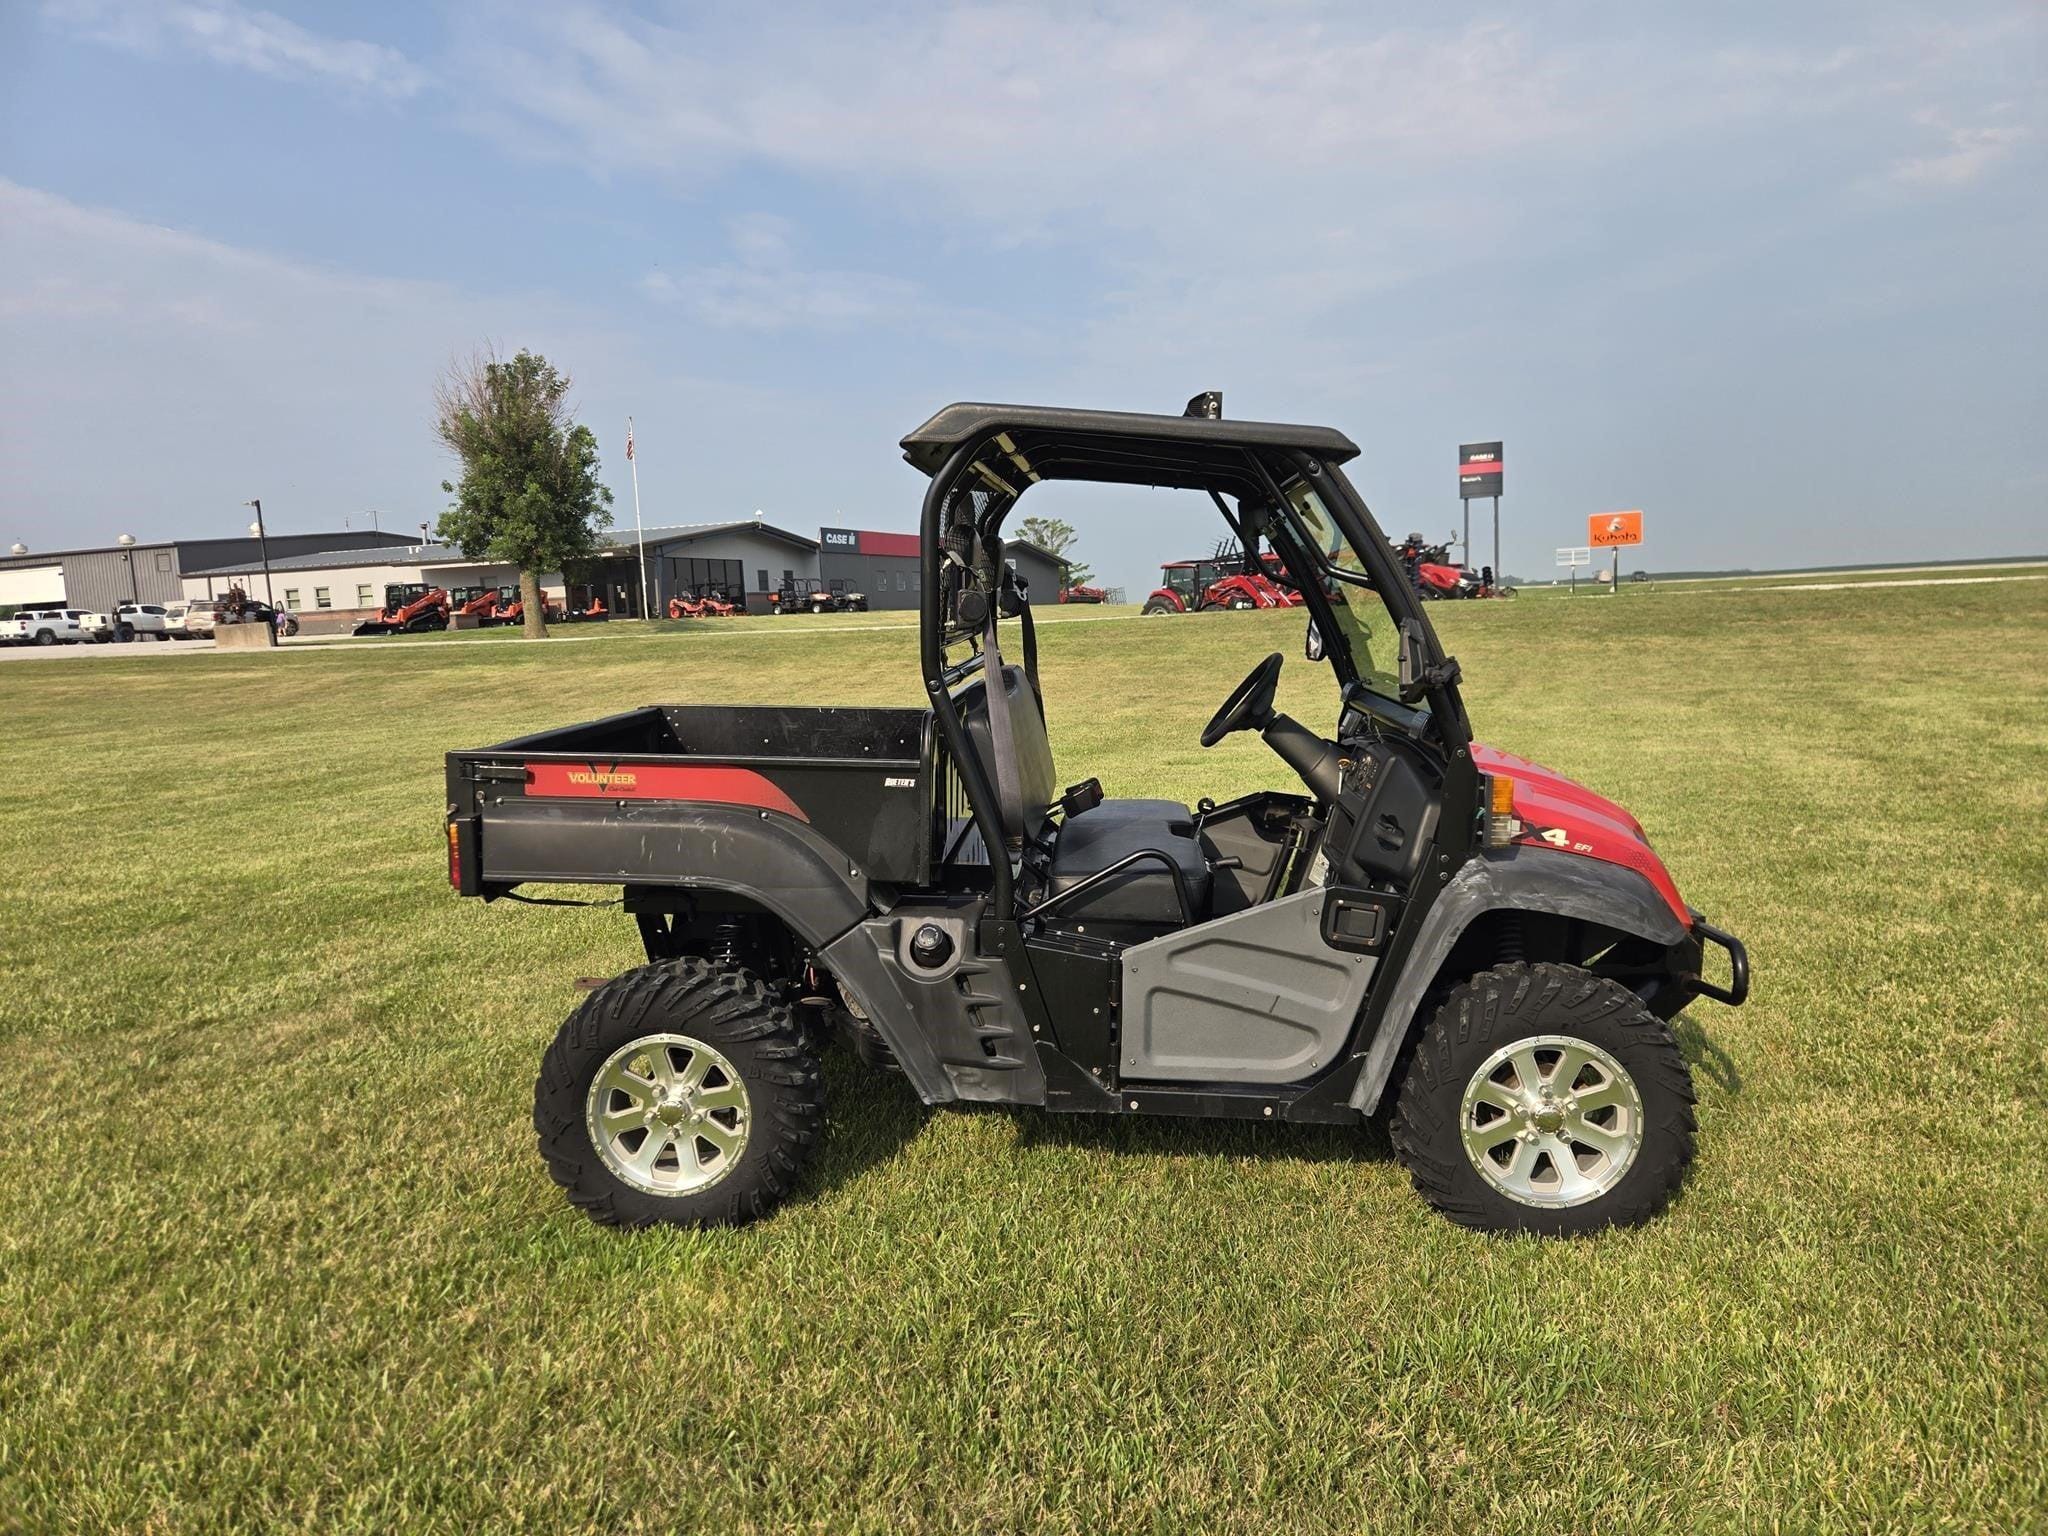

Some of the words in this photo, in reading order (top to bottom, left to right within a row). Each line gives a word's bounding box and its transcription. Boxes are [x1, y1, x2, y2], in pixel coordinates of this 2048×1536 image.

[826, 533, 847, 544] CASE
[1594, 532, 1637, 543] Kubota
[567, 771, 637, 785] VOLUNTEER
[1573, 842, 1594, 853] EFI
